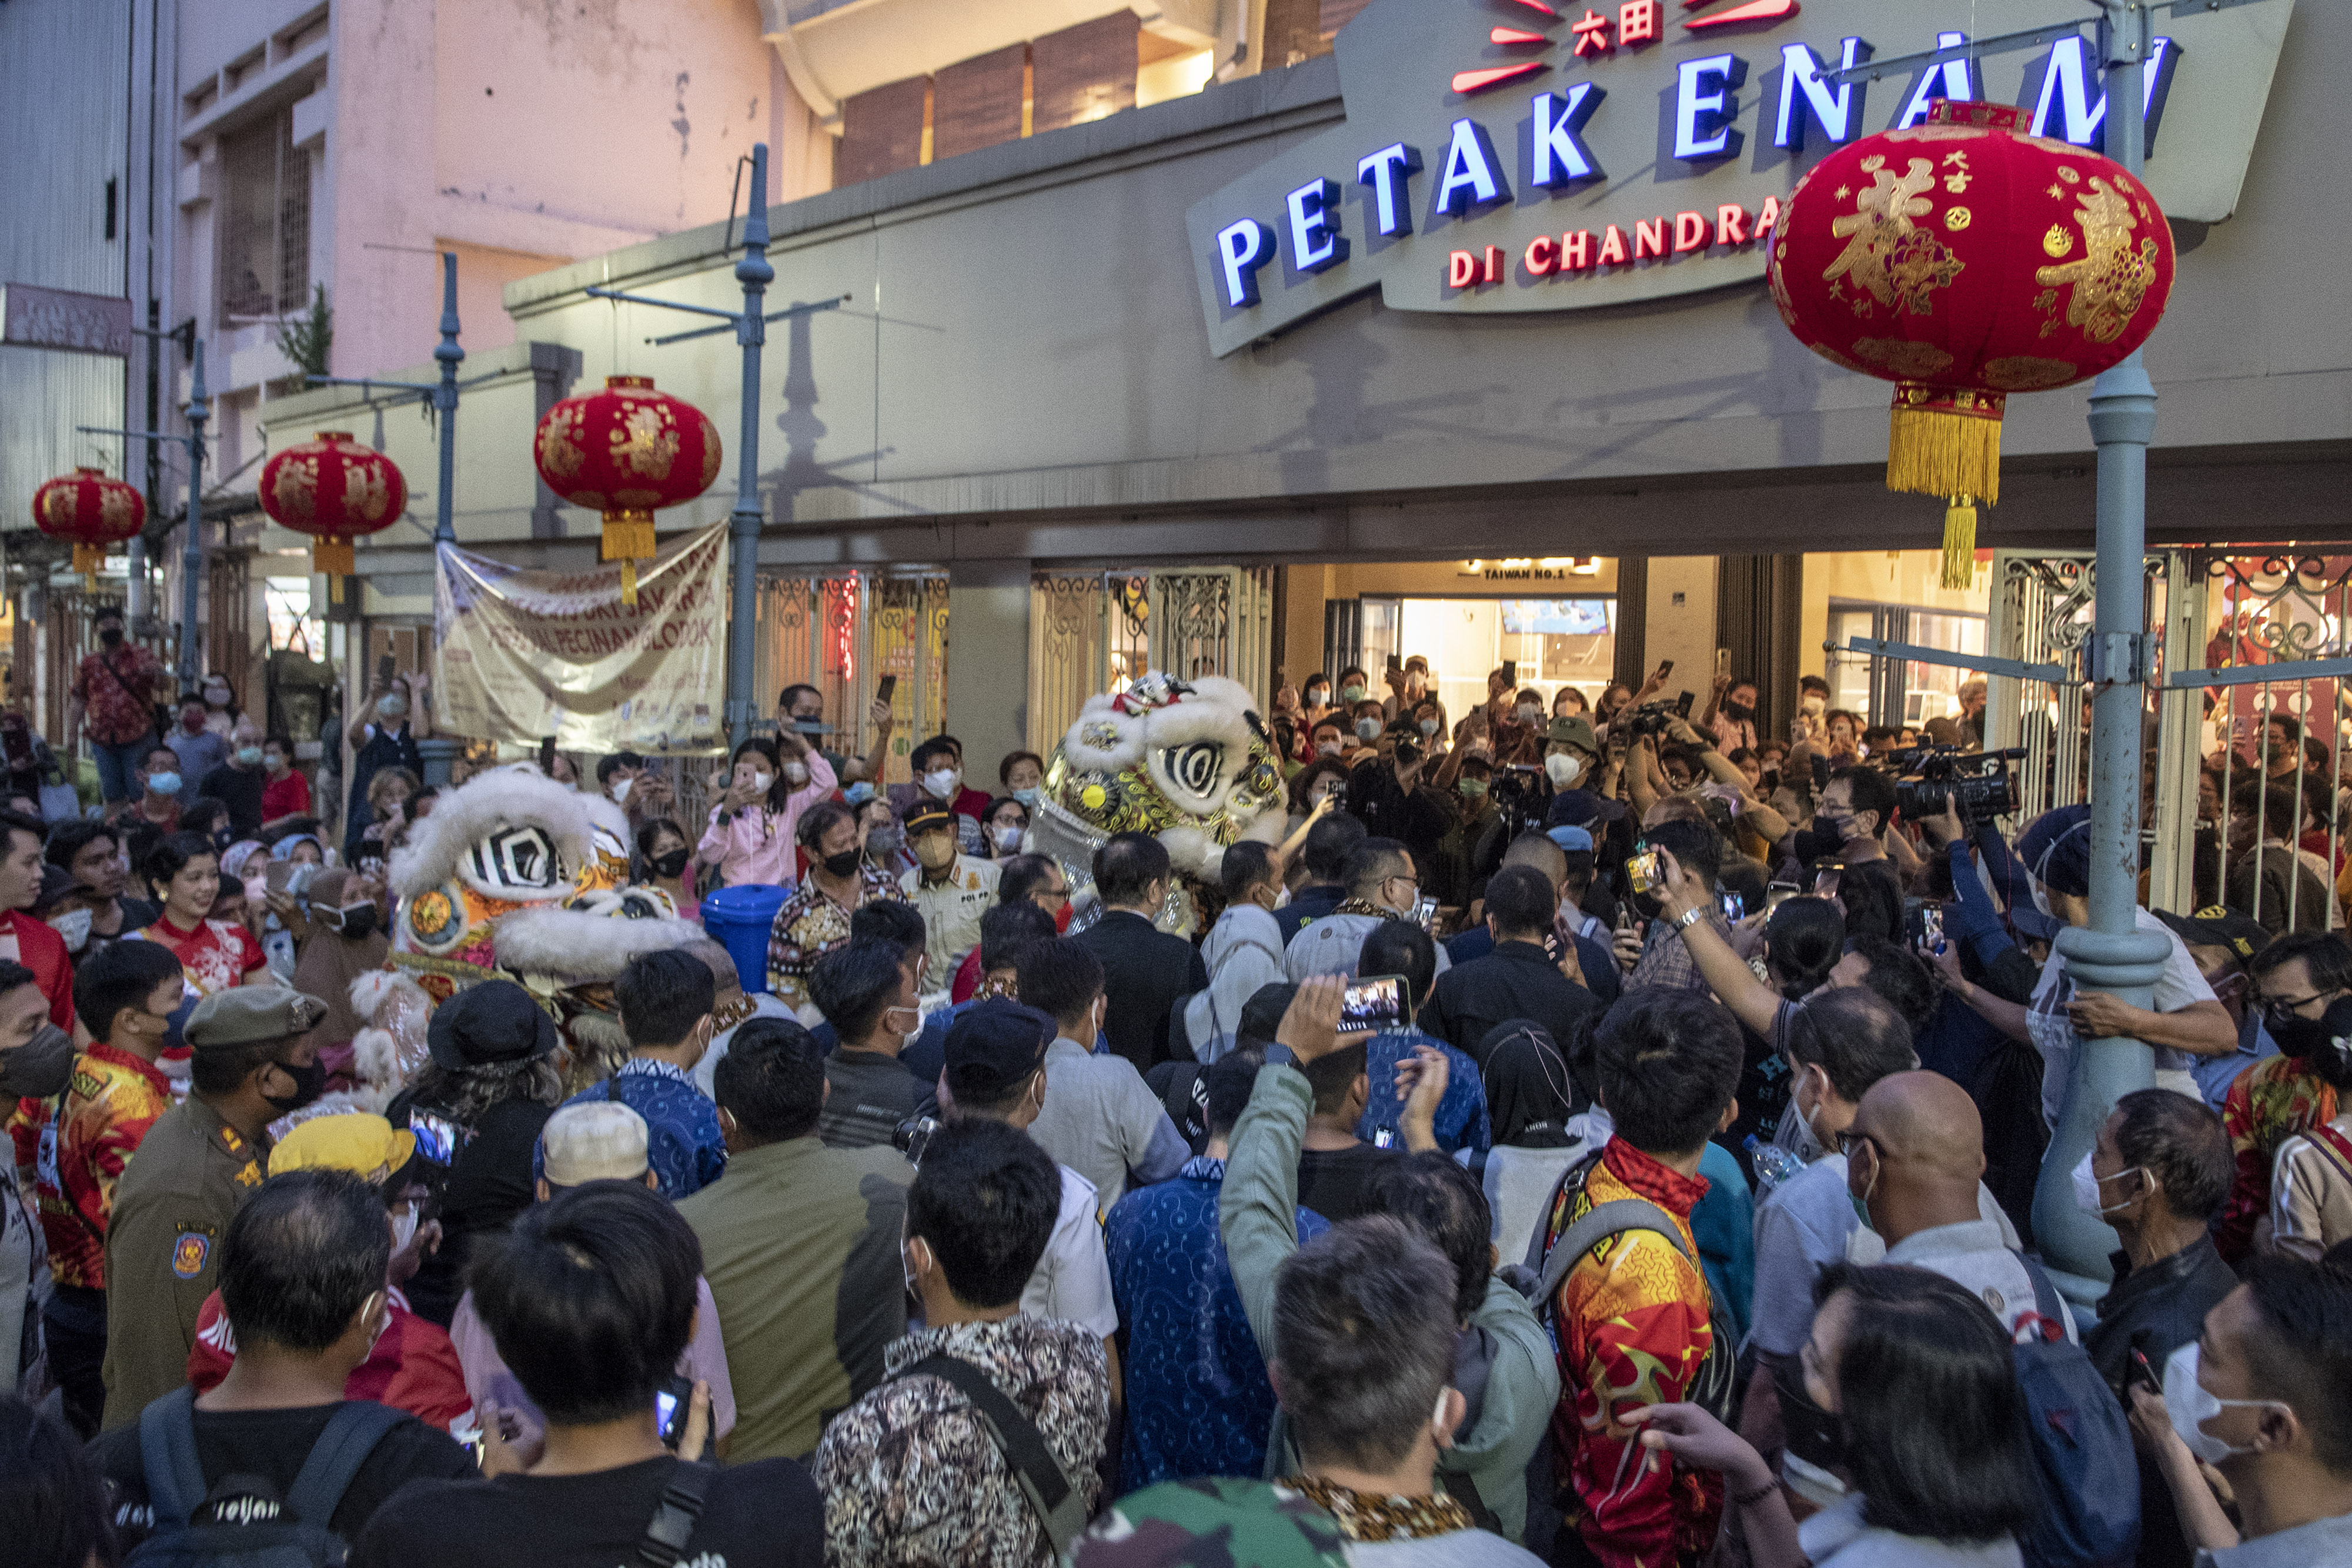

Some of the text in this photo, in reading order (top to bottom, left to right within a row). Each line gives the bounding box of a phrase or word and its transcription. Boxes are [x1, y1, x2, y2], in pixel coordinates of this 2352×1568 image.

[1571, 0, 1654, 56] 六田
[1217, 31, 2172, 307] PETAK ENAM
[1449, 195, 1780, 289] DI CHANDRA
[1484, 569, 1531, 580] TAIWAN
[961, 891, 989, 902] POL PP
